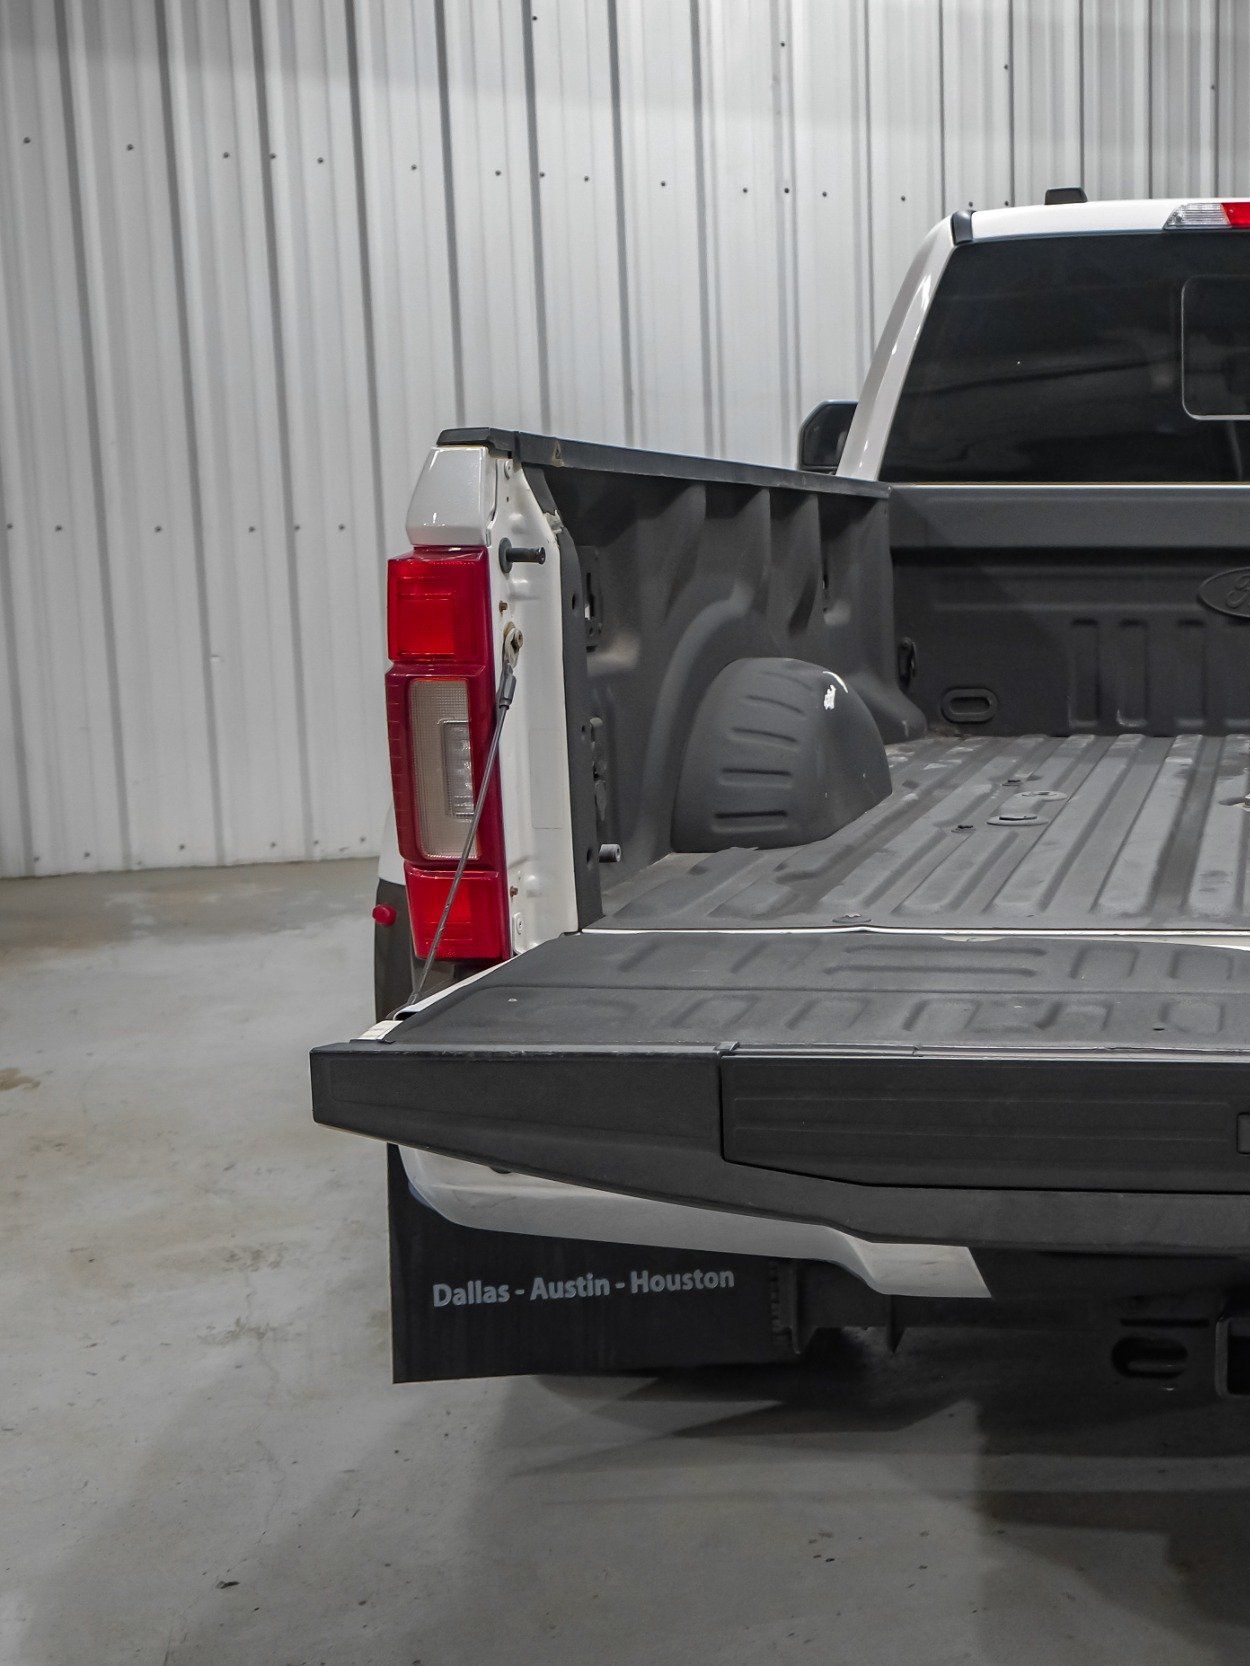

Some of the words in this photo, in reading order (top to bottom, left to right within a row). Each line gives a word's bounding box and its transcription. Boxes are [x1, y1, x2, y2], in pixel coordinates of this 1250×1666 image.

[432, 1279, 511, 1307] Dallas
[529, 1272, 611, 1301] Austin
[630, 1269, 736, 1294] Houston
